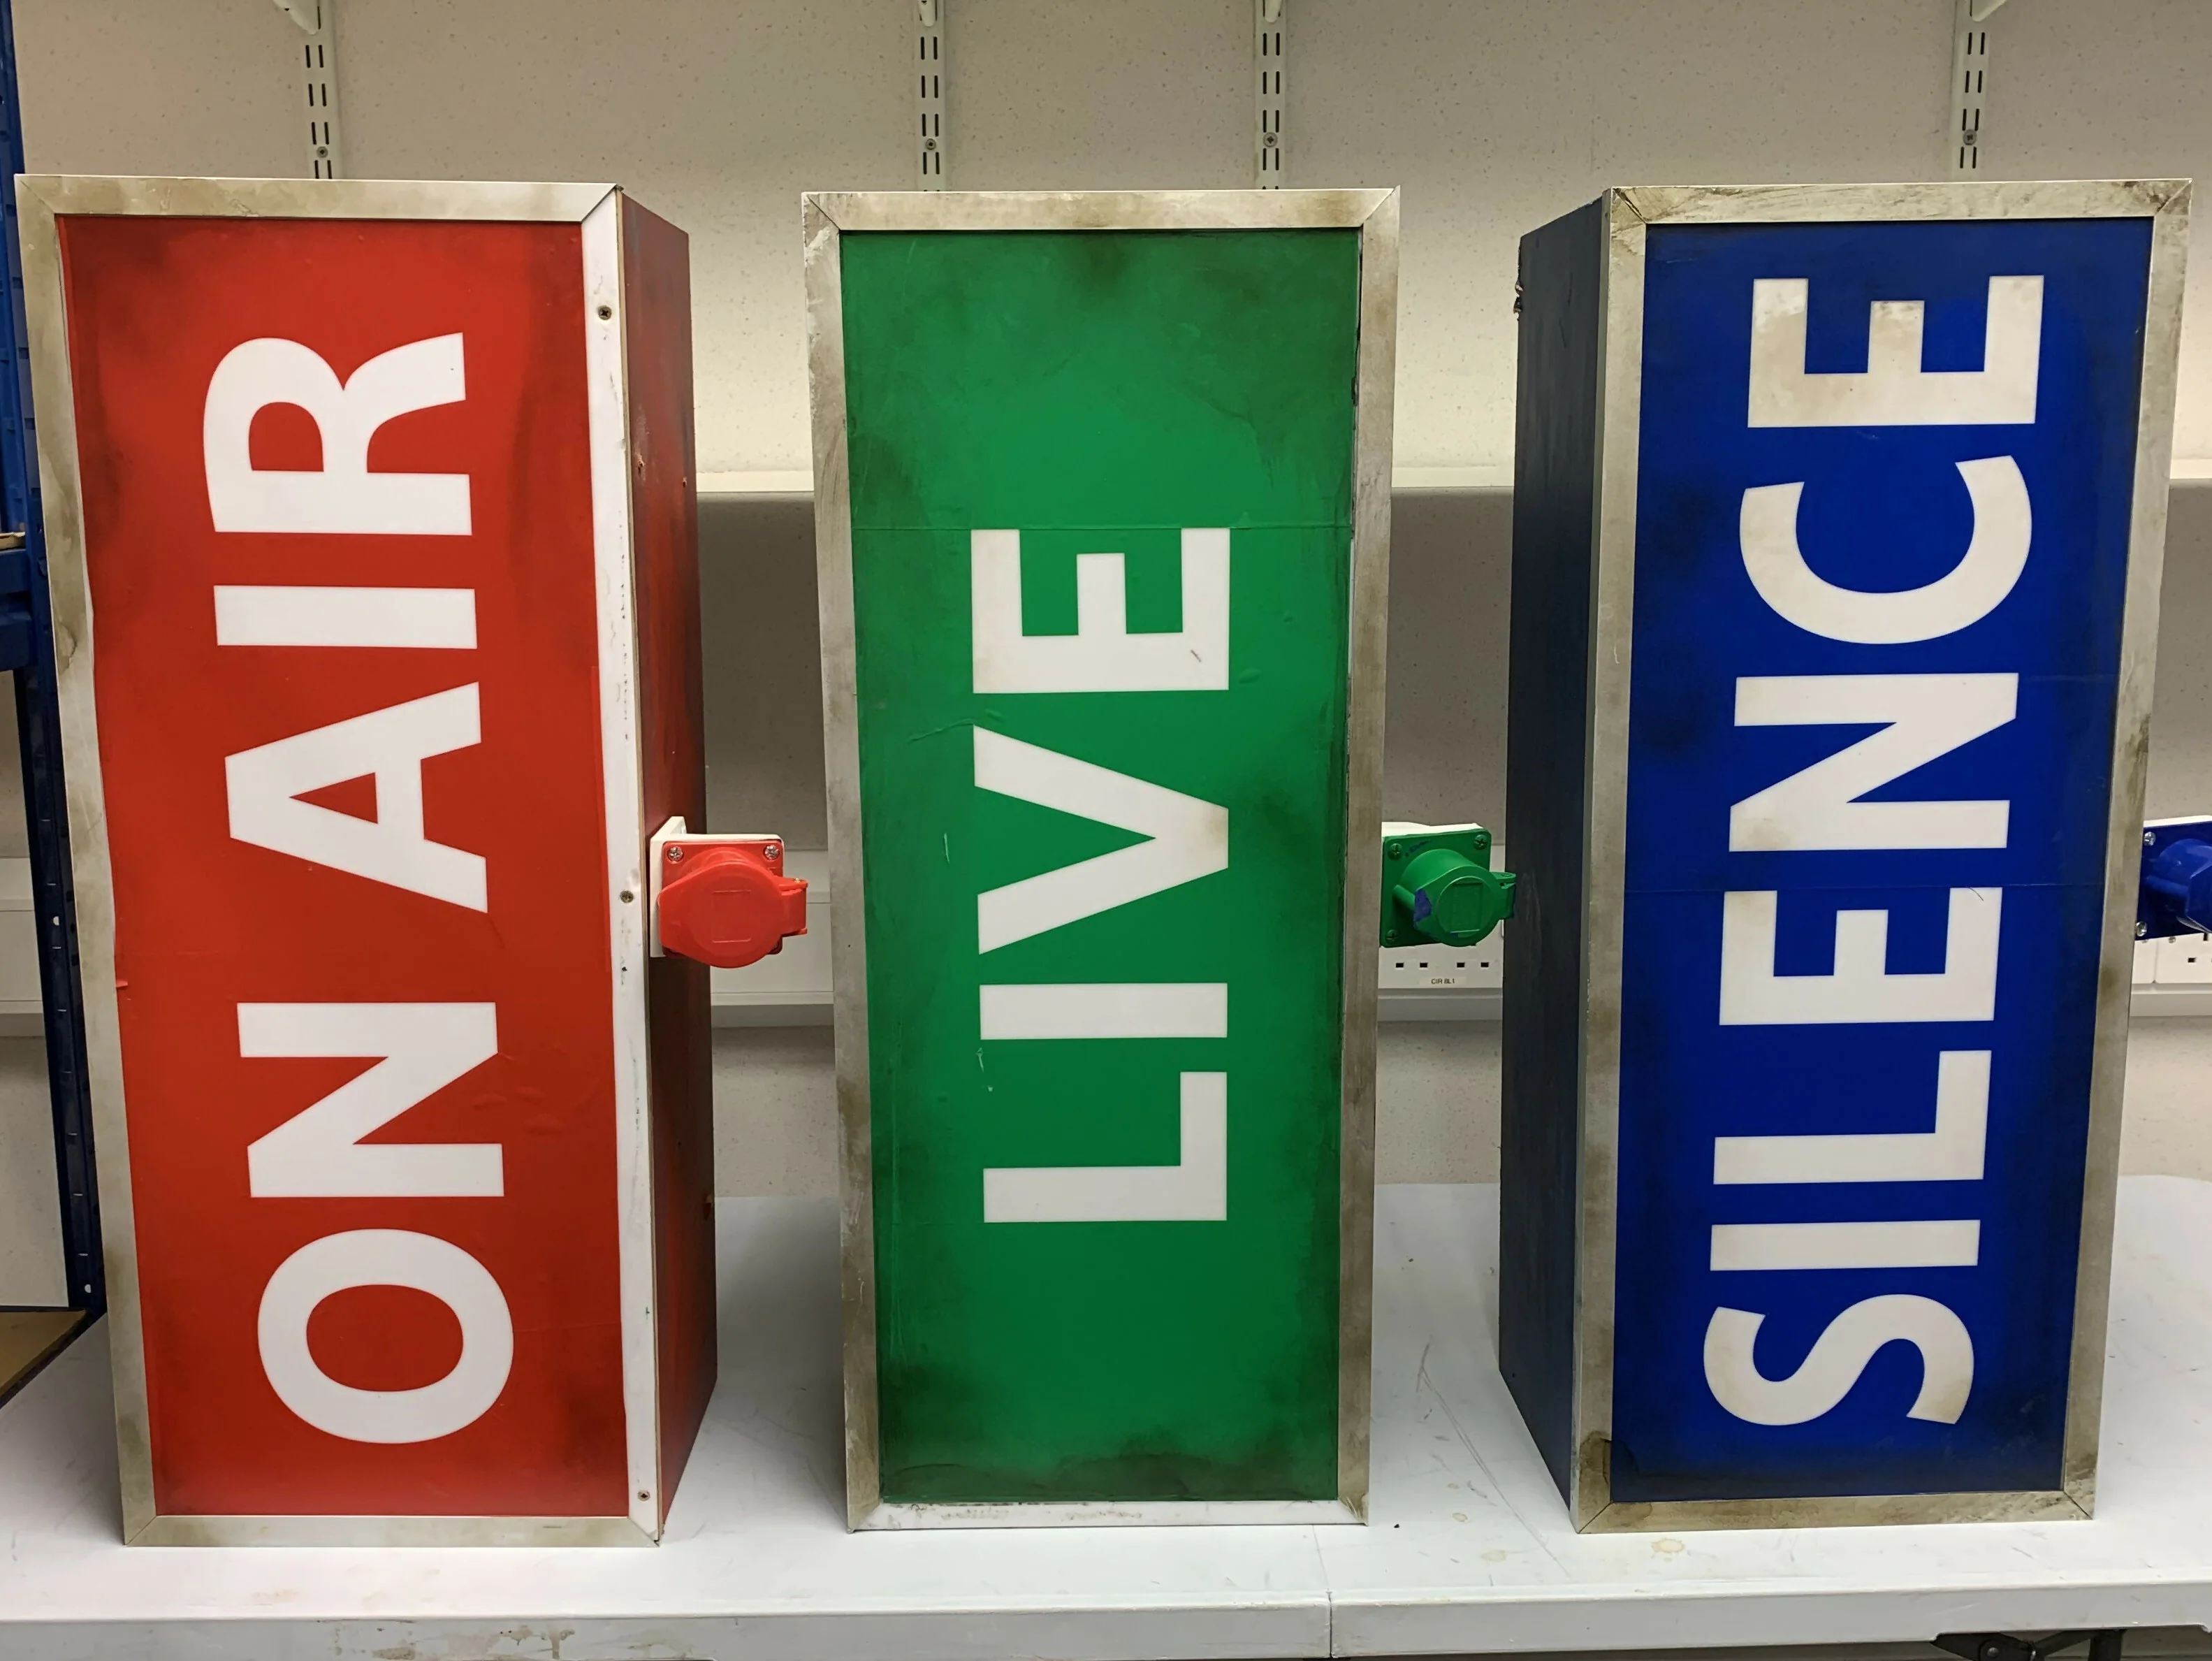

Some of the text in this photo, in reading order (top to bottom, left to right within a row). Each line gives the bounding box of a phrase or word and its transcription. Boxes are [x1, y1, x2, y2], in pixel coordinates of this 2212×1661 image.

[203, 333, 513, 1444] ON AIR
[971, 528, 1231, 1223] LIVE
[1704, 275, 2044, 1426] SILENCE
